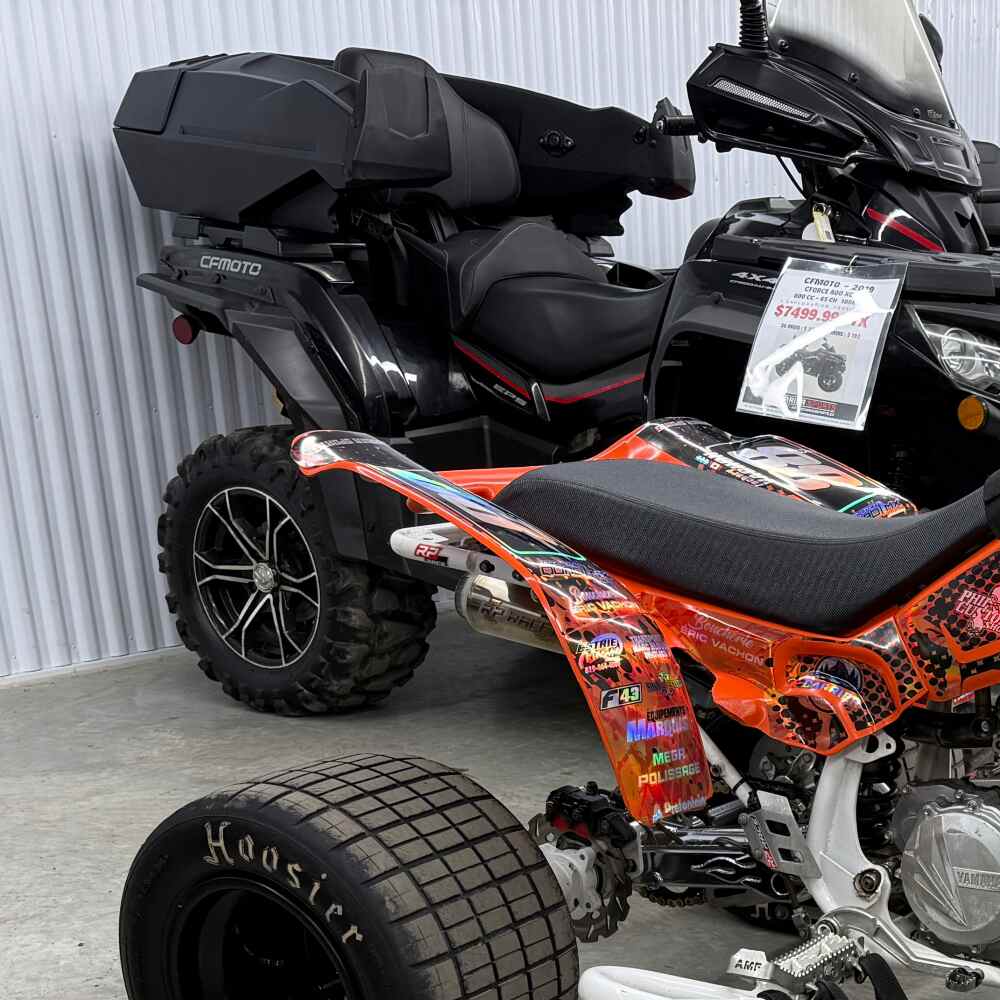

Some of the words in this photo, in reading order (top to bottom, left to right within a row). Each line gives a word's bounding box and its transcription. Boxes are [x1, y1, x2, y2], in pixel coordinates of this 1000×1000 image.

[200, 255, 262, 276] CFMOTO
[804, 277, 840, 287] CFMOTO
[680, 624, 710, 643] ERIC
[711, 639, 766, 666] VACHON
[203, 820, 364, 944] Hoosier
